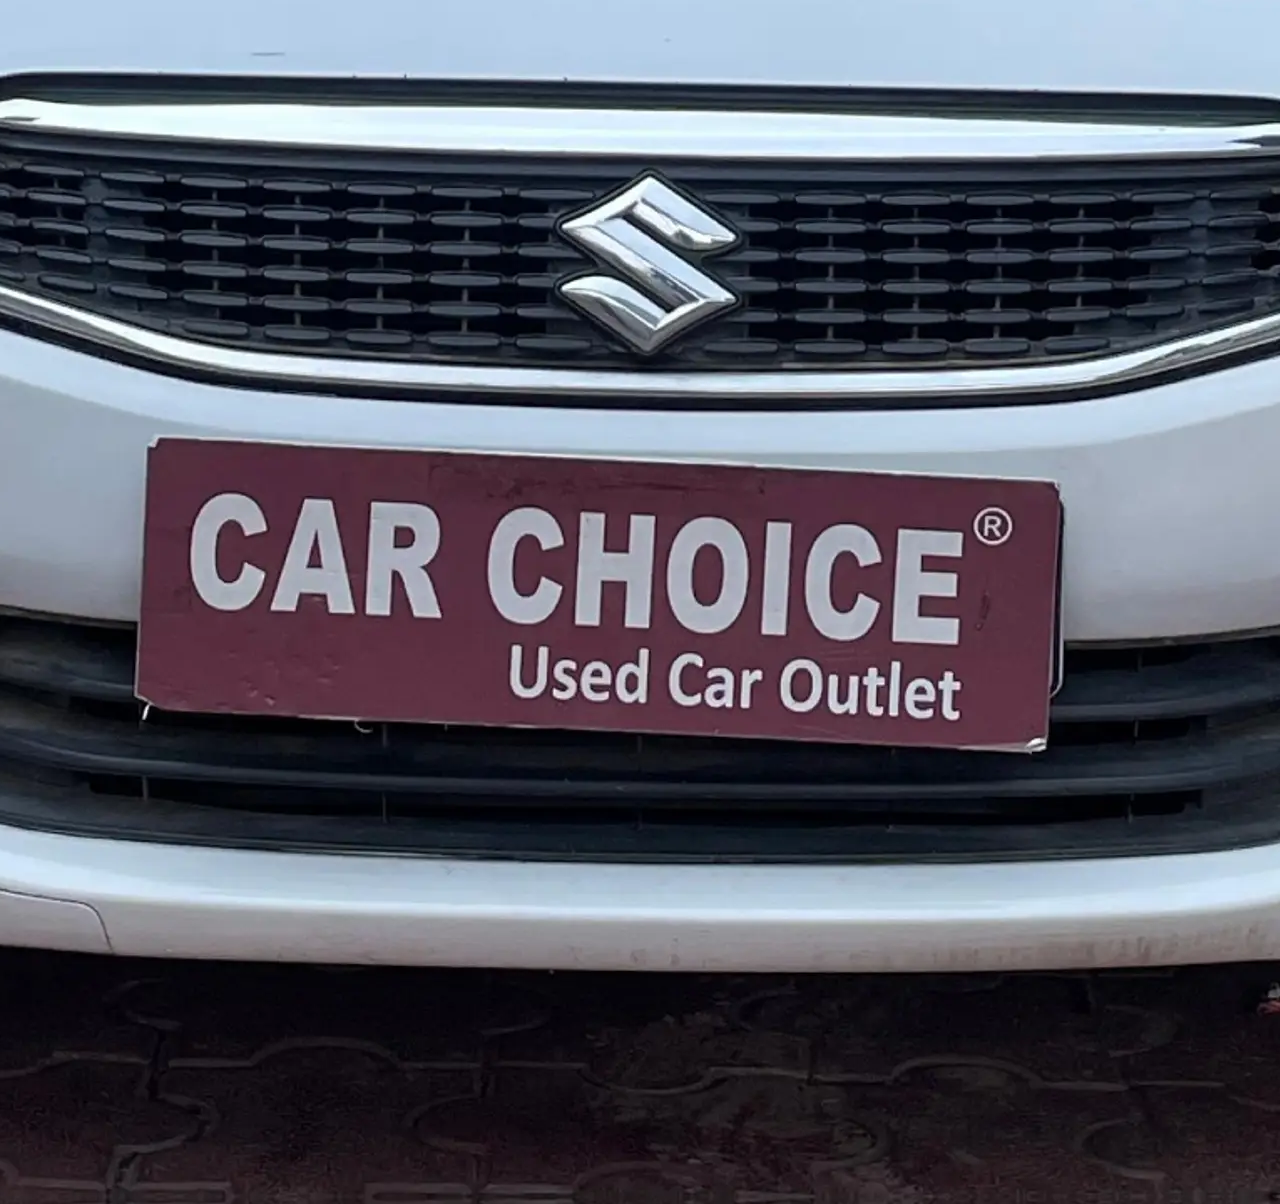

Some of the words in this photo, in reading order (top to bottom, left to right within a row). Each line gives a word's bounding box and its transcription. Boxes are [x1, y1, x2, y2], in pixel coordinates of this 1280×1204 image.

[191, 494, 441, 618] CAR
[511, 645, 648, 703] Used
[669, 654, 762, 708] Car
[781, 660, 960, 720] Outlet
